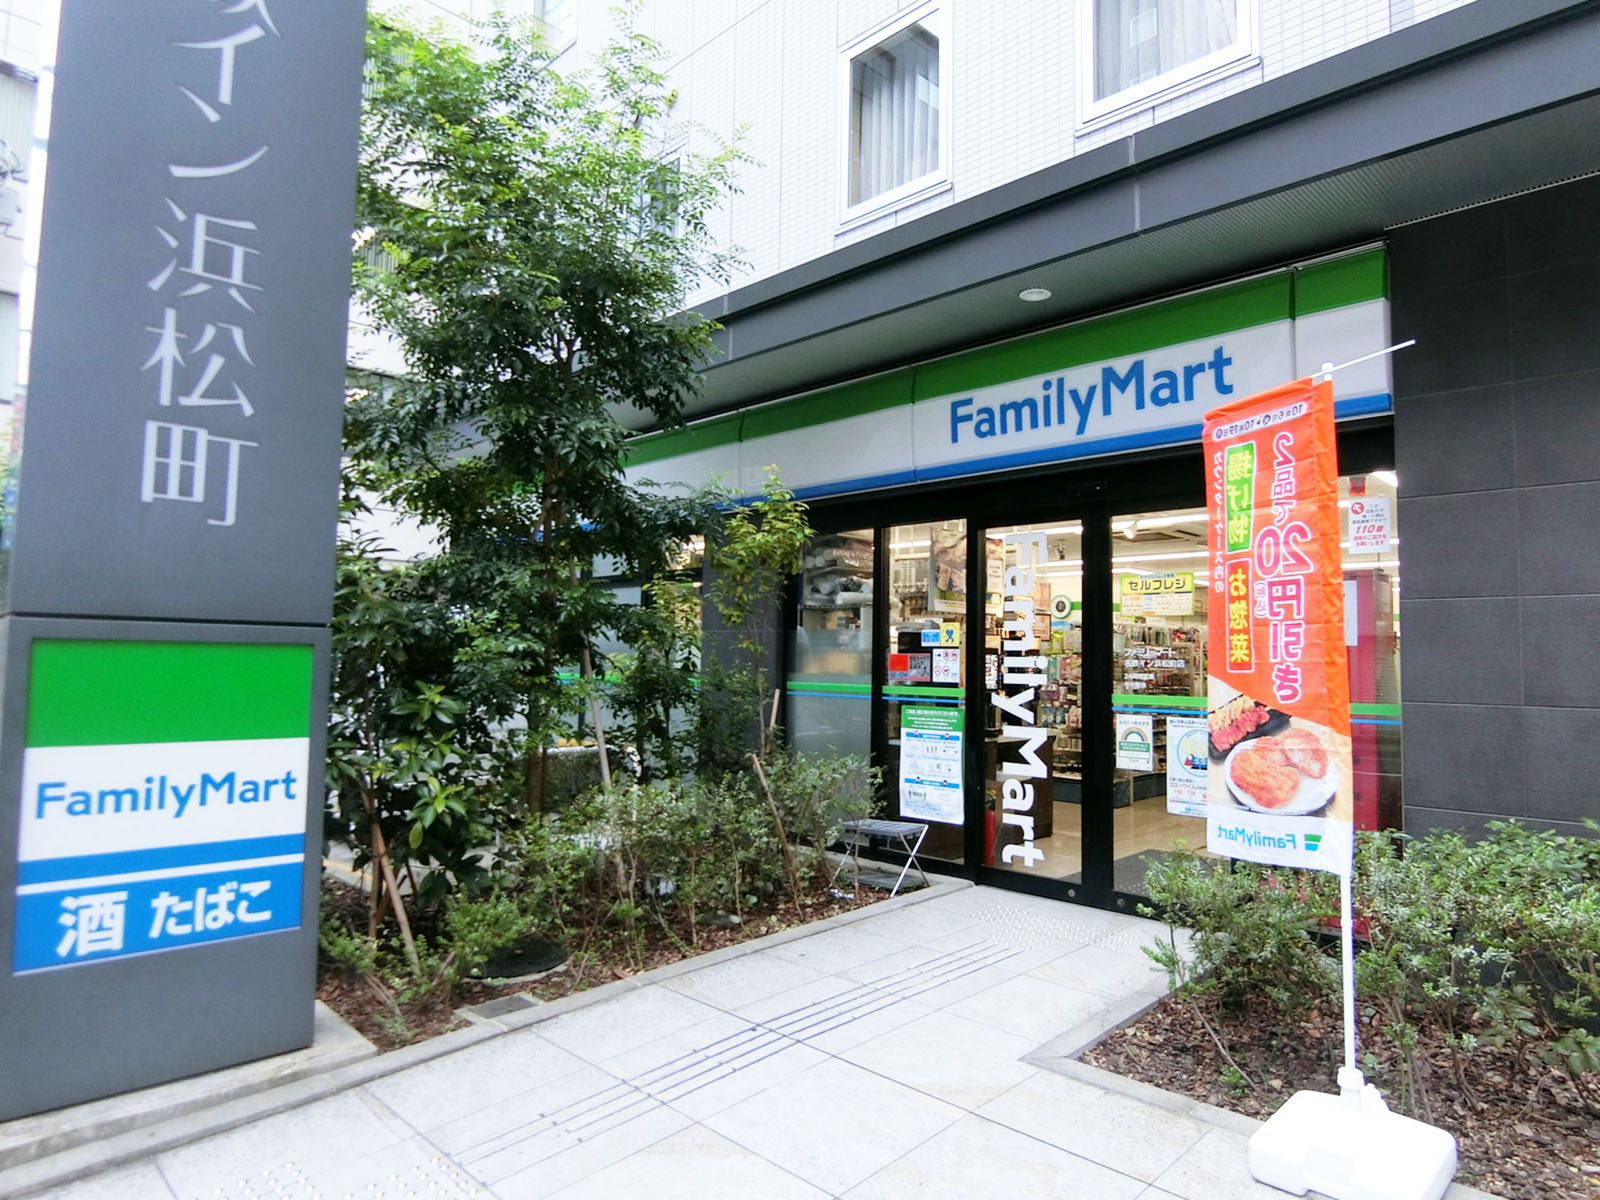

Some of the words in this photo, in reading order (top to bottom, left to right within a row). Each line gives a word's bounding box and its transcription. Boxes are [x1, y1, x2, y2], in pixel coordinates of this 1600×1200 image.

[950, 346, 1234, 444] FamilyMart
[1128, 577, 1186, 591] セルフレジ
[1123, 647, 1177, 658] ファミリーマート
[991, 532, 1048, 868] FamilyMart
[35, 770, 297, 820] FamilyMart
[55, 890, 129, 958] 酒
[149, 879, 272, 939] たばこ
